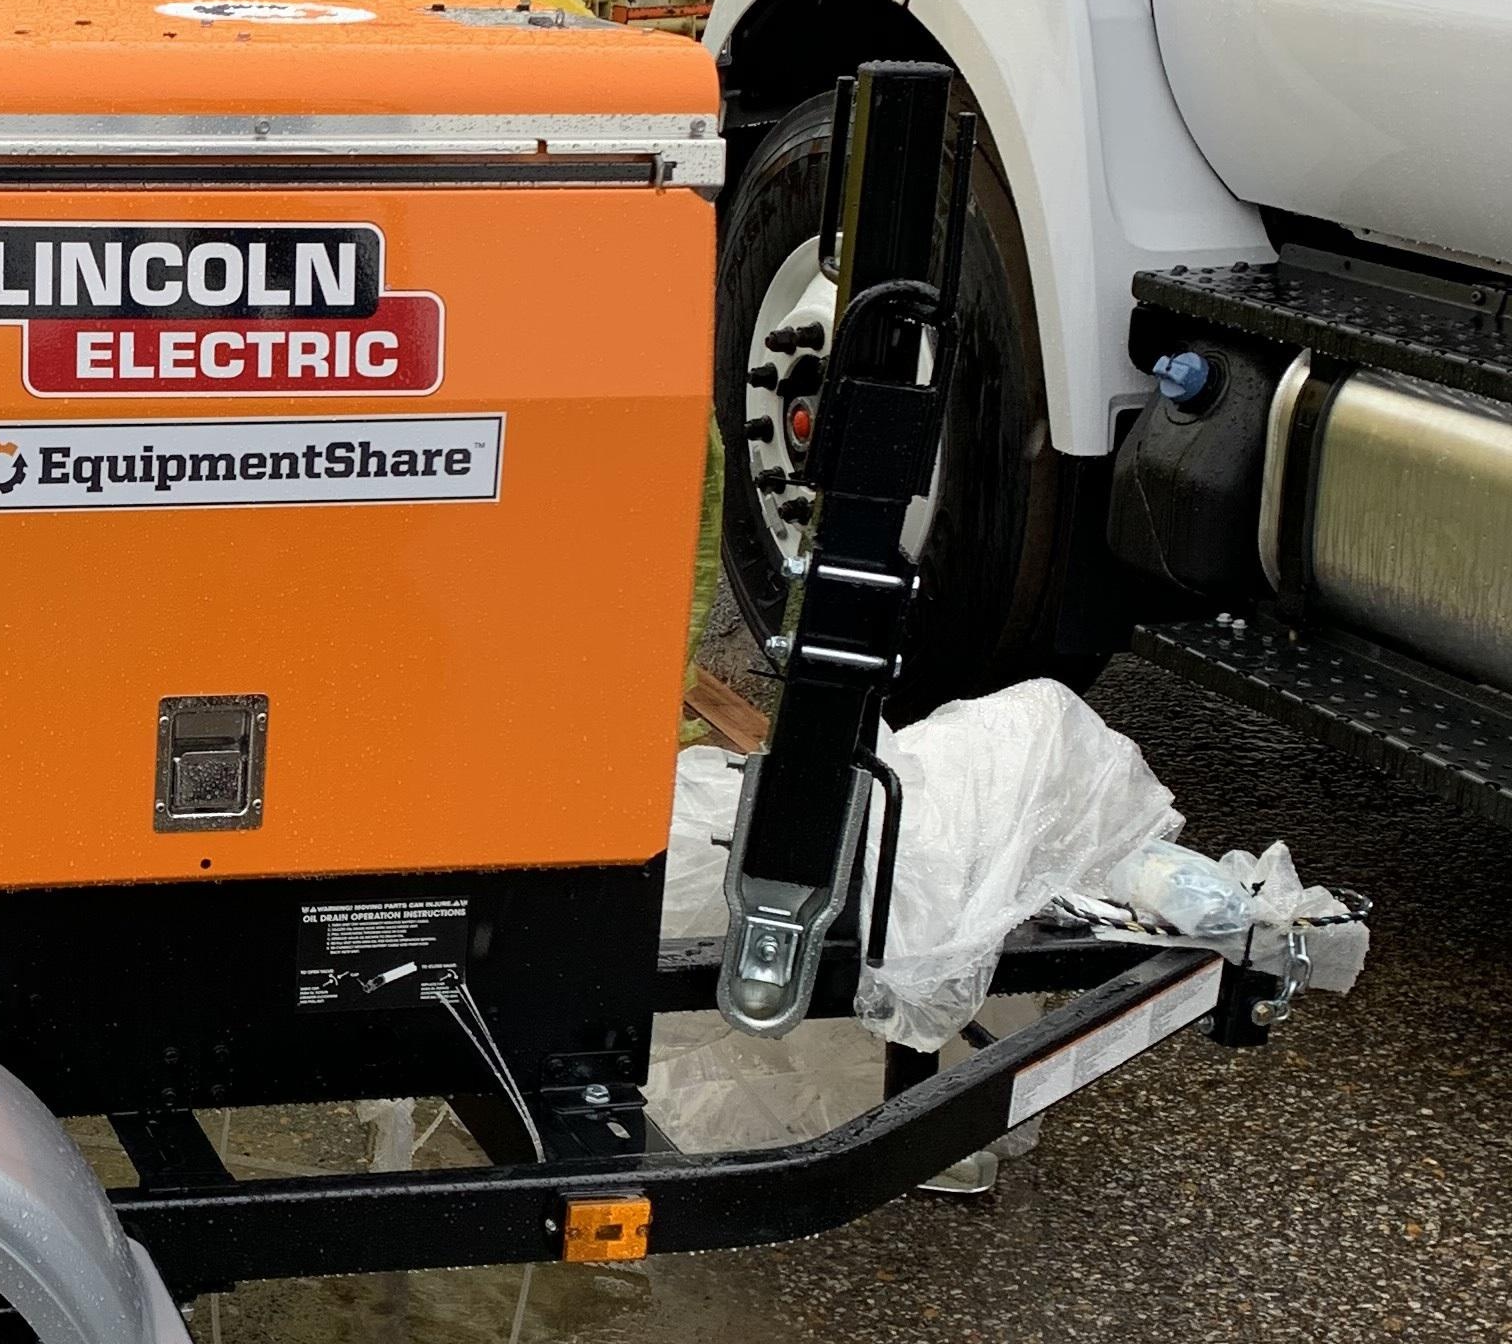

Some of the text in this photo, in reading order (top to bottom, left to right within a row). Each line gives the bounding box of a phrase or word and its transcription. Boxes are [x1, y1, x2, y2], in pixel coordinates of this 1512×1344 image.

[75, 330, 399, 380] ELECTRIC
[38, 441, 472, 493] EquipmentShare
[303, 908, 466, 923] OIL DRAIN OPERATION INSTRUCTIONS
